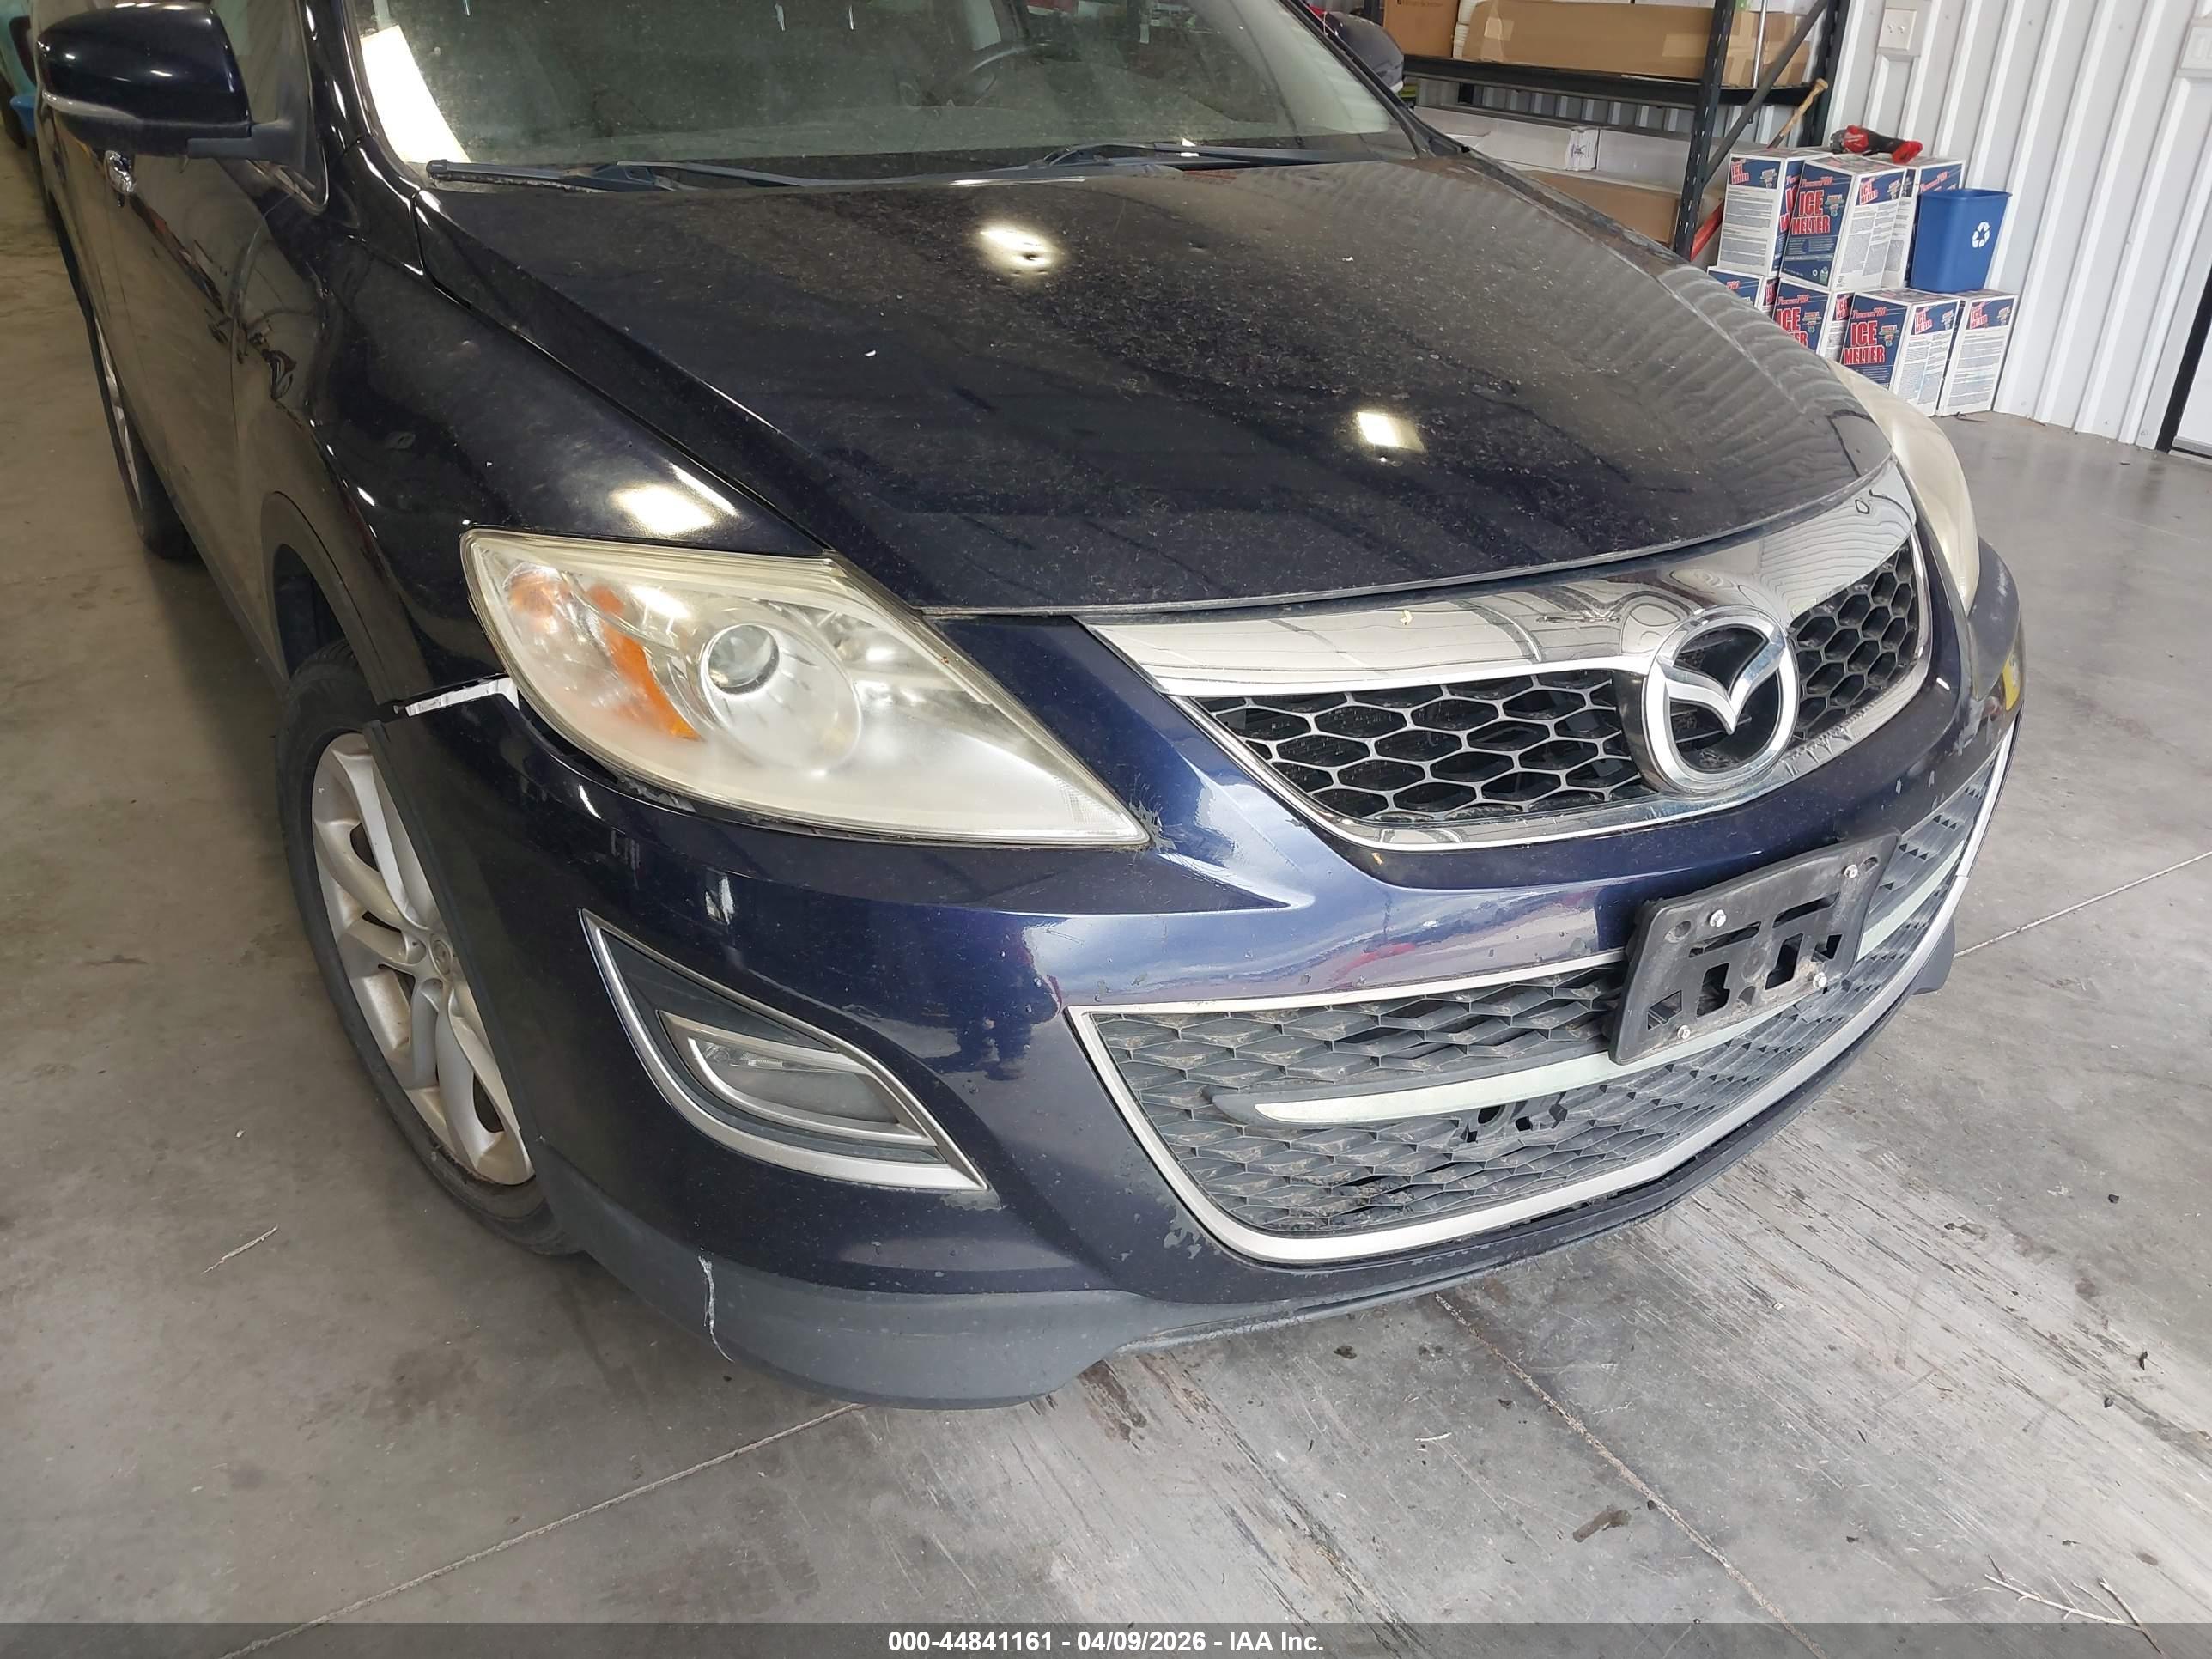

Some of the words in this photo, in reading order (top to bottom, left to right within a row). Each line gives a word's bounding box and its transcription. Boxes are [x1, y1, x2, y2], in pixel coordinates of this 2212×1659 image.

[1798, 190, 1824, 216] ICE
[1791, 215, 1830, 235] MELTER
[1776, 307, 1801, 331] ICE
[1850, 320, 1878, 346] ICE
[1843, 344, 1886, 365] MELTER
